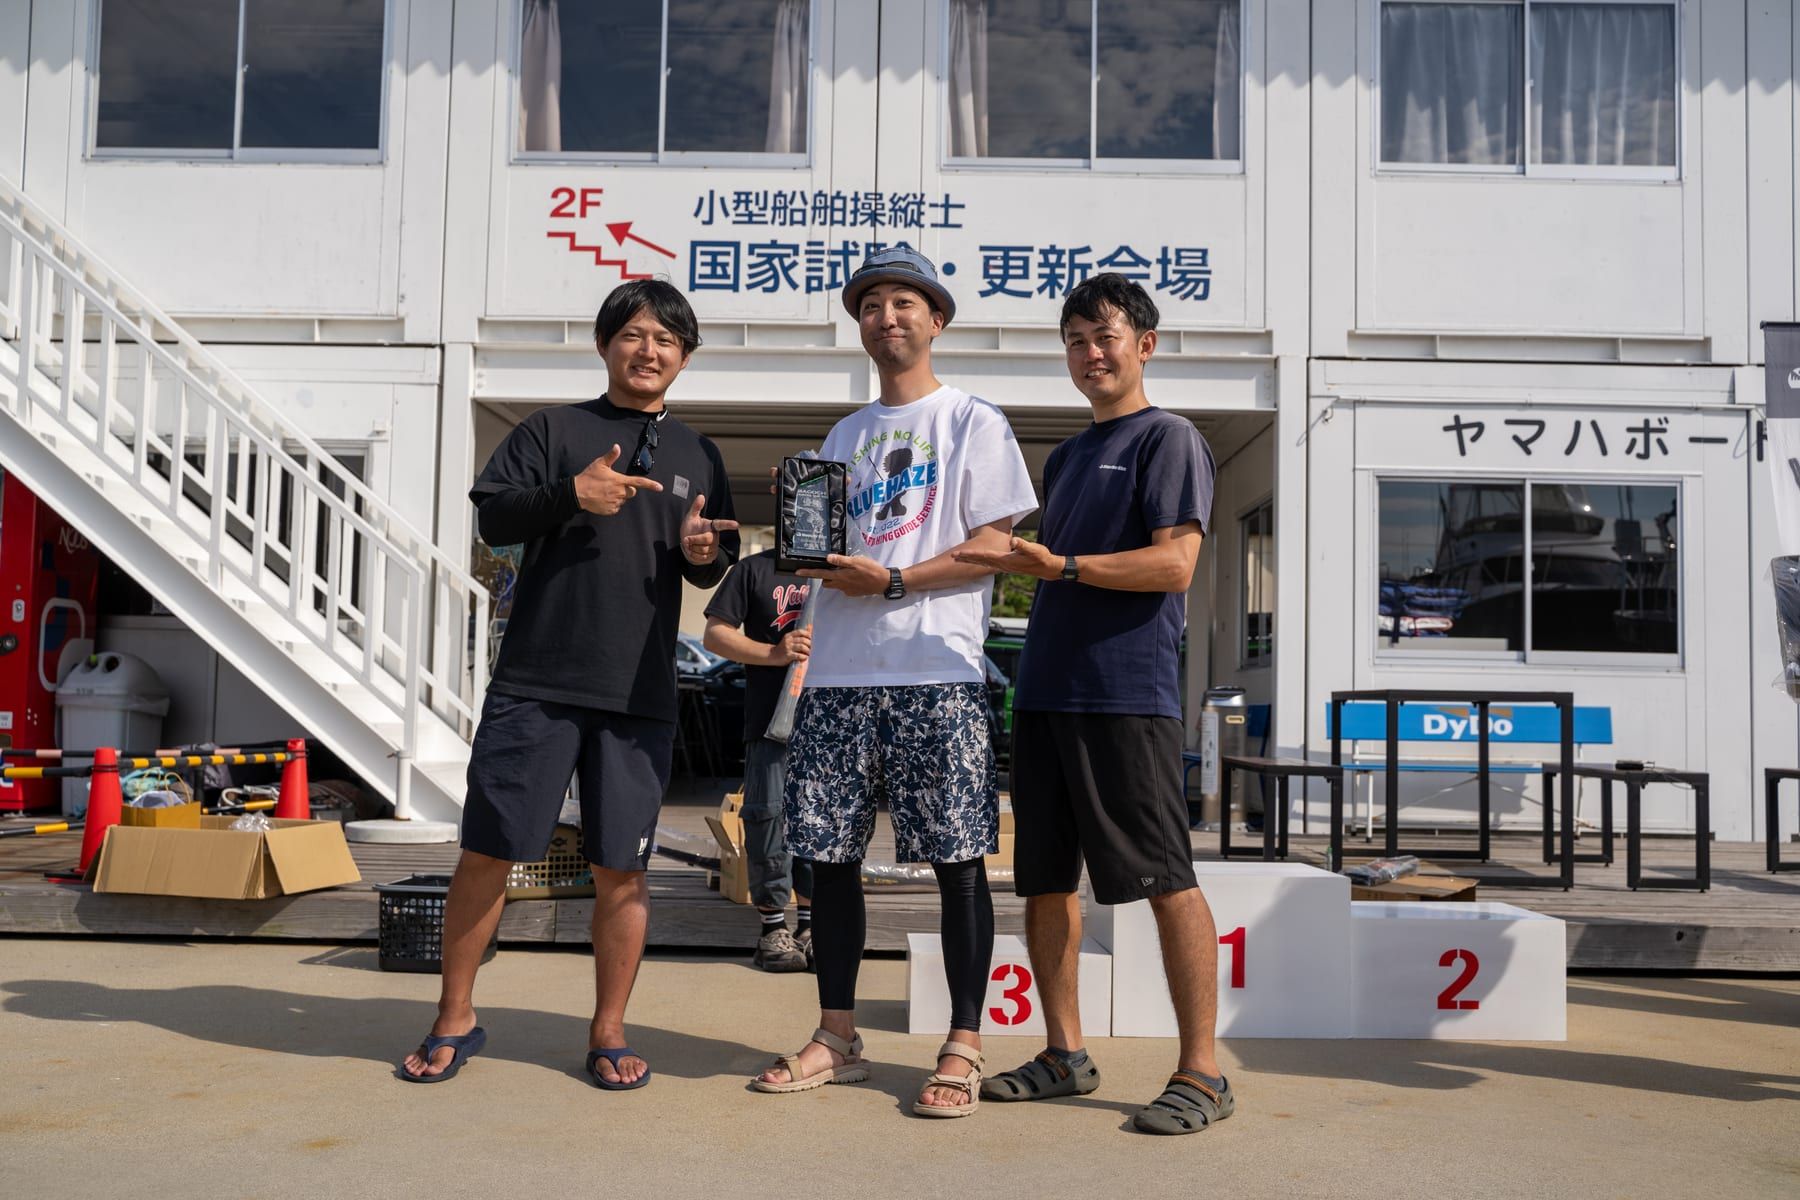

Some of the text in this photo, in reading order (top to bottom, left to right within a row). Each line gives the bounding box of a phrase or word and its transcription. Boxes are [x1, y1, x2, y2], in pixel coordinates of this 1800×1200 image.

[549, 187, 603, 218] 2F
[693, 189, 966, 229] 小型船舶操縦士
[688, 240, 1212, 301] 国家試・更新会場
[893, 430, 912, 441] NO
[913, 435, 936, 460] LIFE
[893, 518, 920, 539] GUIDE
[915, 484, 938, 524] SERVICE
[1423, 713, 1514, 740] DyDo
[1219, 926, 1246, 989] 1
[1437, 948, 1480, 1010] 2
[989, 963, 1032, 1026] 3
